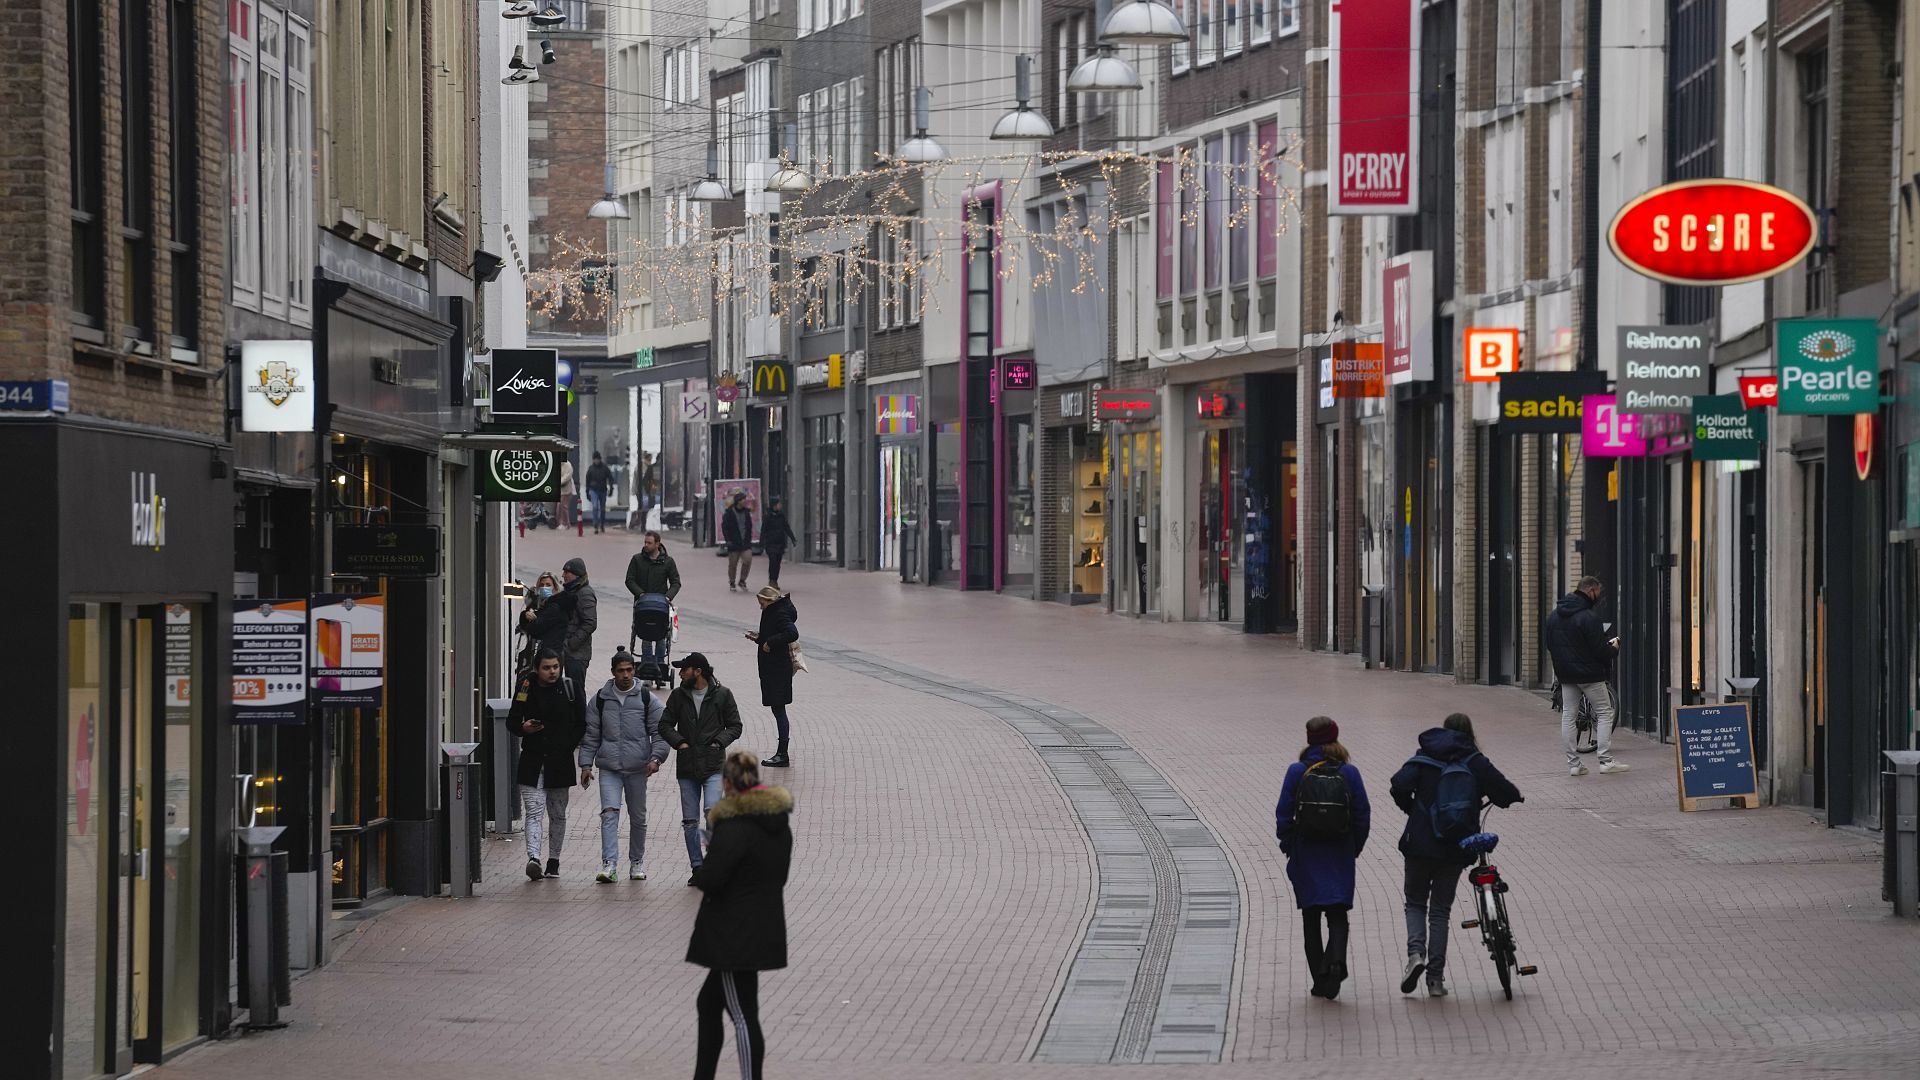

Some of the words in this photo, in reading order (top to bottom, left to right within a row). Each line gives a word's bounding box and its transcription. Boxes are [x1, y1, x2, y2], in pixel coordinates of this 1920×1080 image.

[1342, 152, 1406, 190] PERRY
[1653, 212, 1776, 252] SCORE
[1480, 341, 1502, 369] B
[1335, 359, 1382, 370] DISTRIKT
[496, 367, 551, 395] Lovisa
[1782, 364, 1873, 390] Pearle
[1747, 383, 1778, 399] Le
[1805, 393, 1850, 403] opticiens
[1503, 395, 1584, 417] sacha
[1696, 414, 1747, 426] Holland
[1707, 427, 1754, 439] Barrett
[511, 450, 532, 459] THE
[503, 460, 541, 470] BODY
[505, 471, 539, 481] SHOP
[233, 625, 272, 633] TELEFOON
[273, 625, 299, 633] STUK?
[270, 654, 298, 662] garantie
[233, 681, 260, 695] 10%
